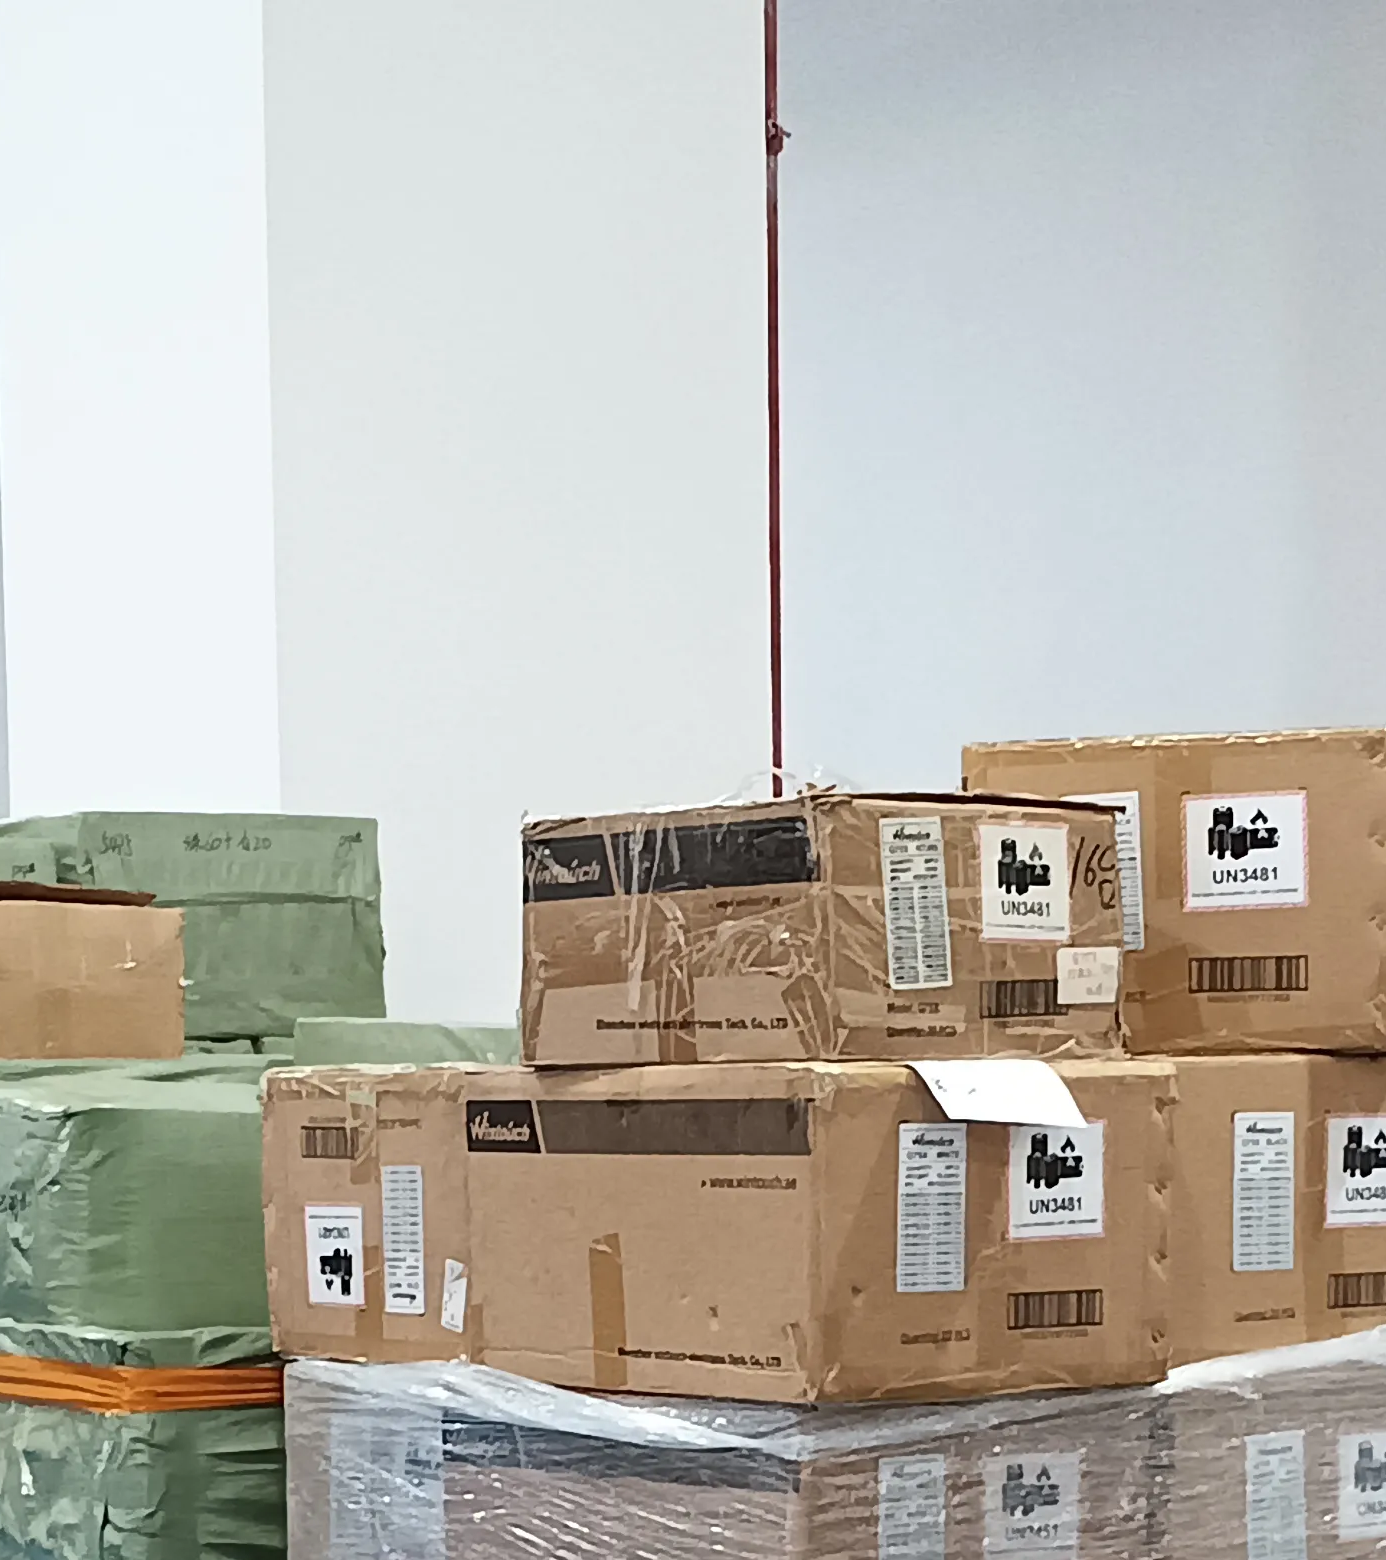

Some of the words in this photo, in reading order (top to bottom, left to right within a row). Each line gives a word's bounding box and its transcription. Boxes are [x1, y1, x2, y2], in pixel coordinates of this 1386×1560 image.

[1213, 867, 1278, 884] UN3481
[1001, 900, 1051, 917] UN3481
[1029, 1197, 1082, 1214] UN3481
